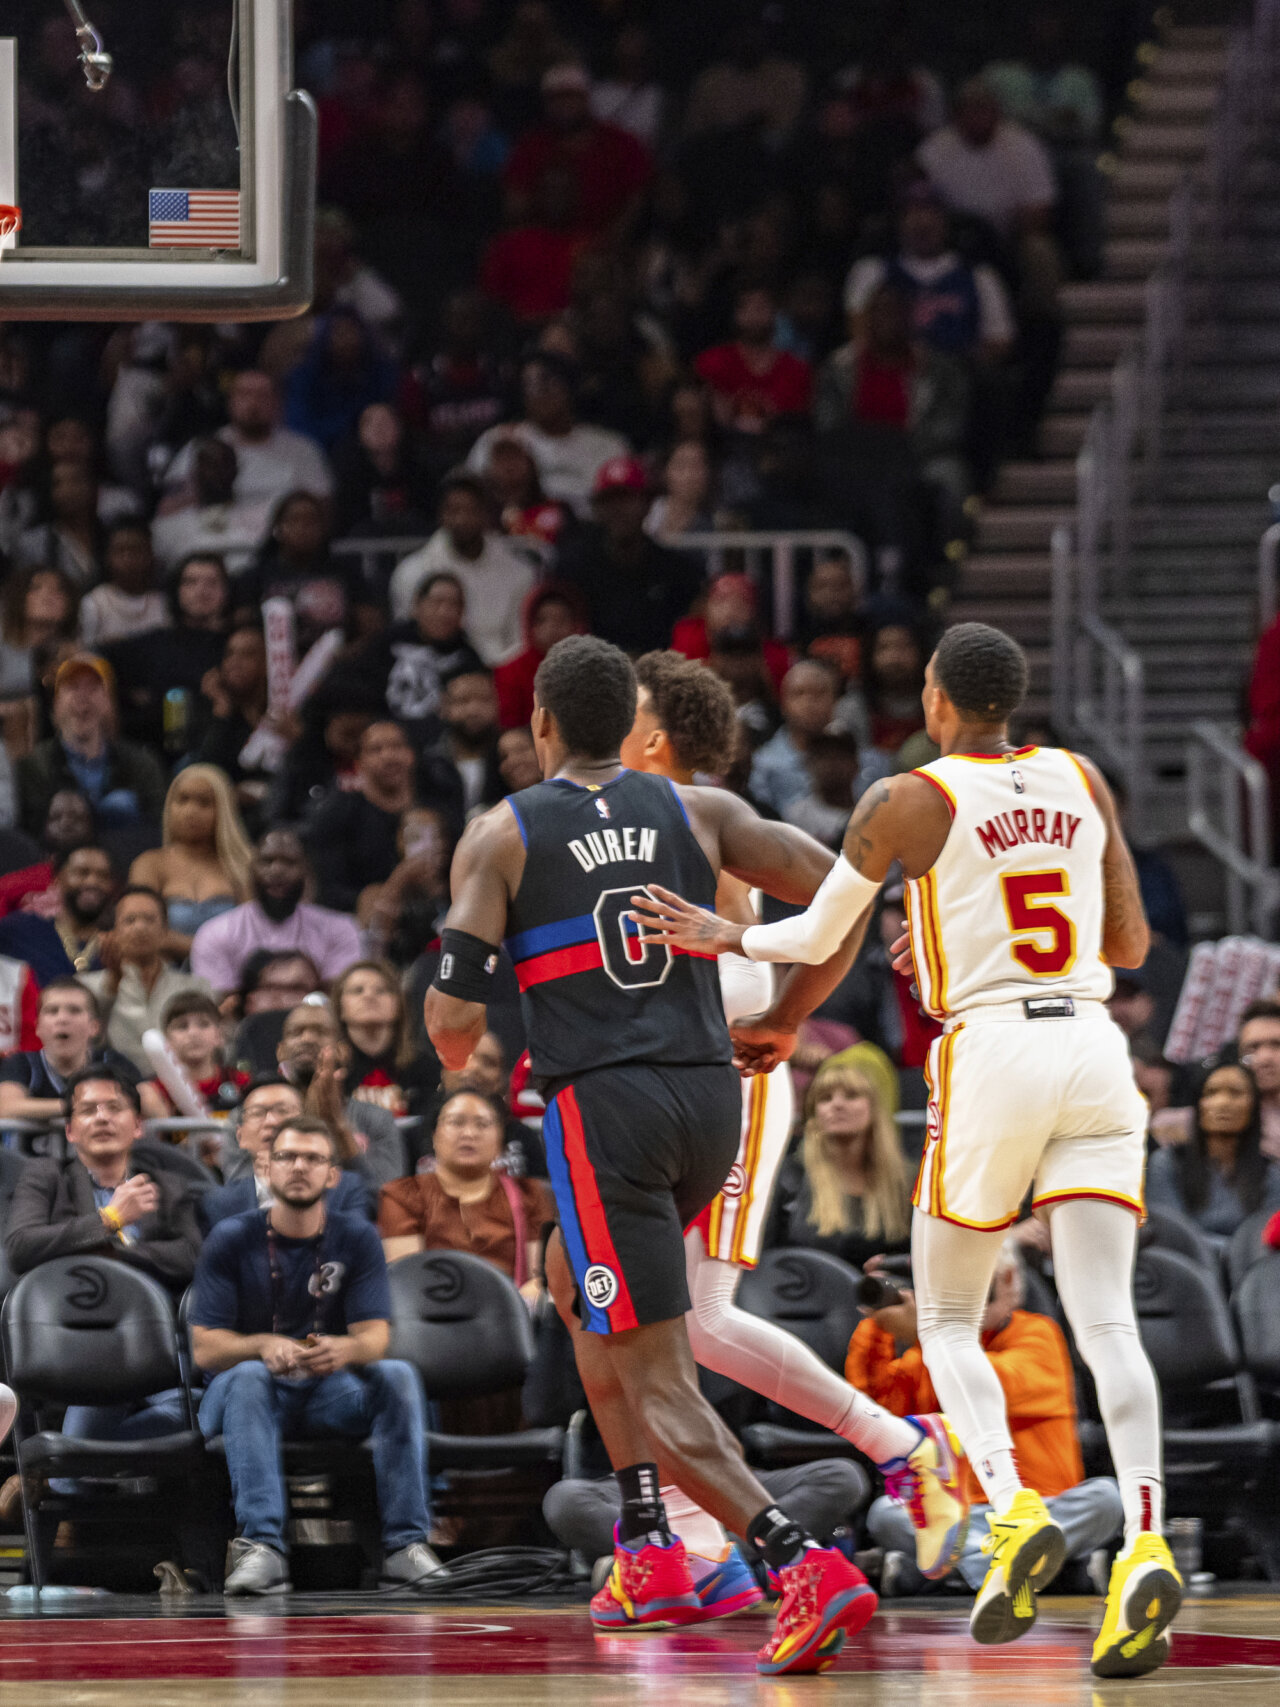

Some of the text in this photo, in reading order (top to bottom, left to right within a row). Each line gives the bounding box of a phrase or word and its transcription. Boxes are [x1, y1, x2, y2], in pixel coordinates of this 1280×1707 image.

[567, 827, 658, 873] DUREN
[975, 809, 1082, 859] MURRAY
[592, 885, 675, 990] 0
[999, 868, 1077, 978] 5
[588, 1276, 611, 1297] DET
